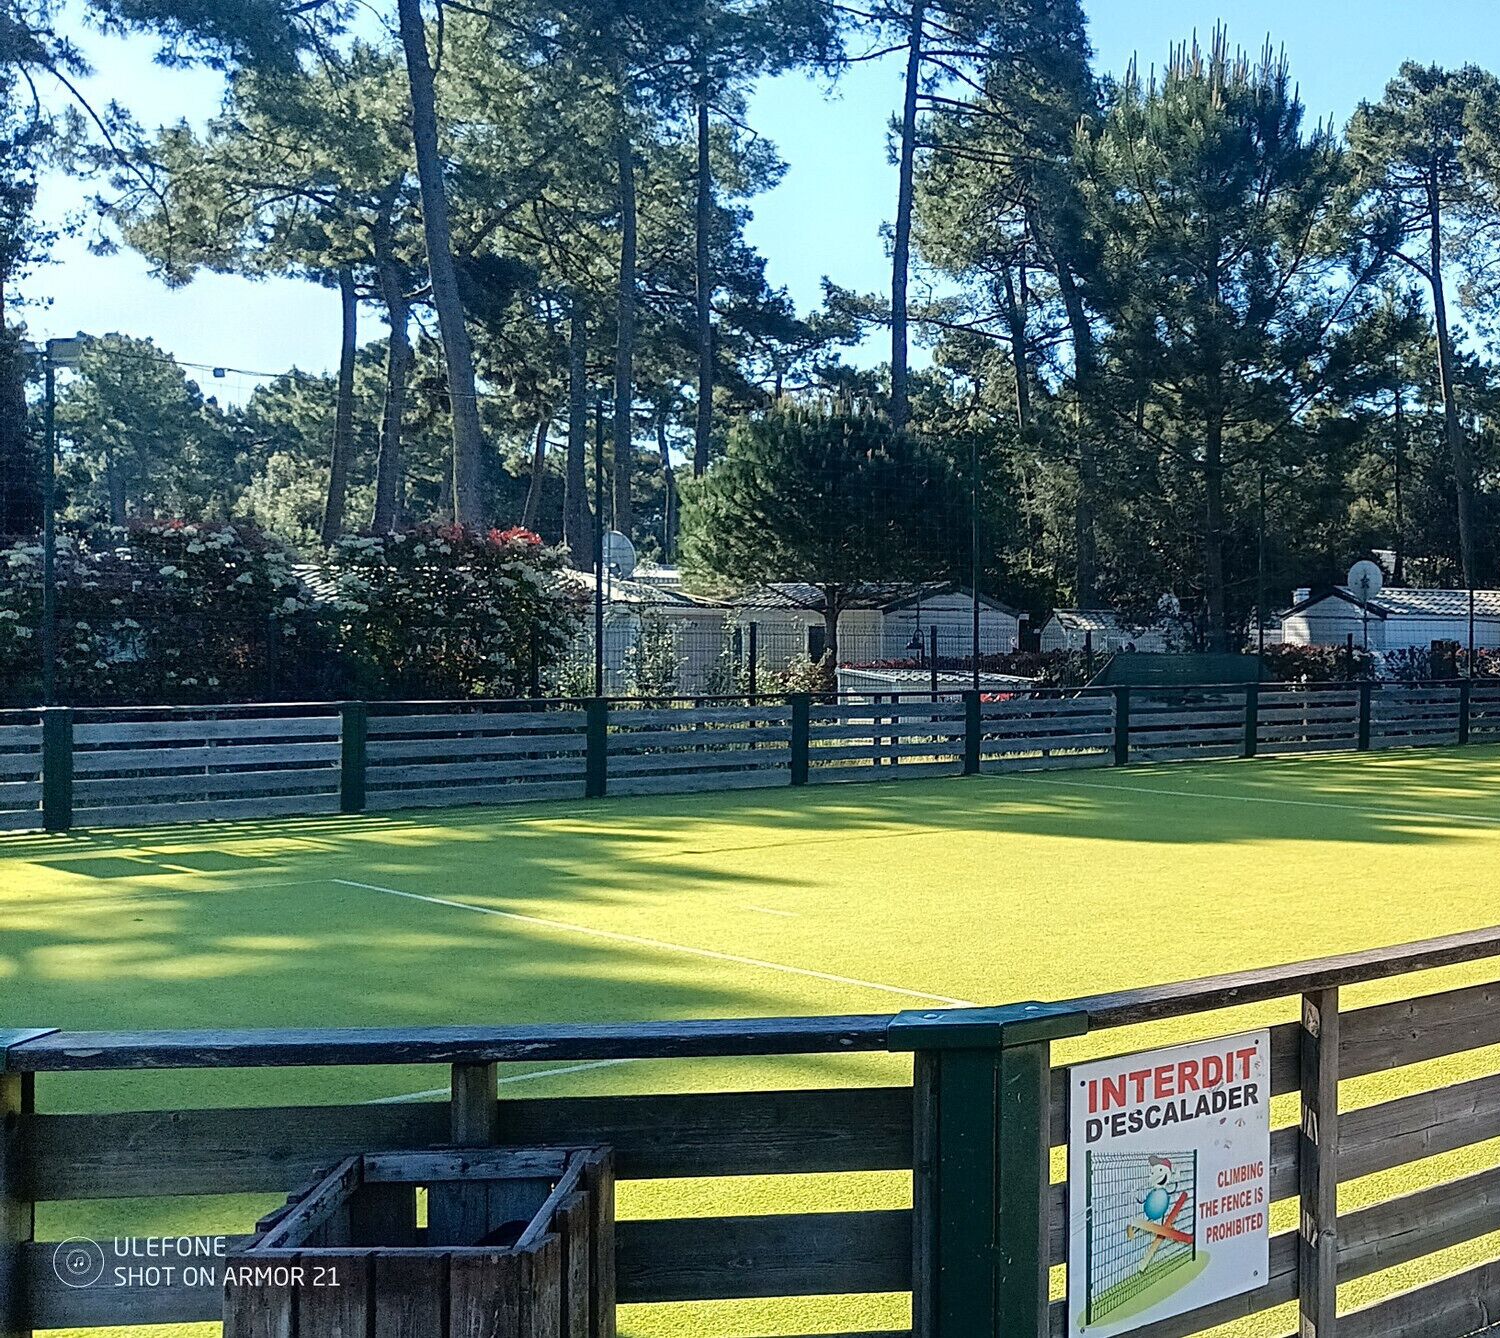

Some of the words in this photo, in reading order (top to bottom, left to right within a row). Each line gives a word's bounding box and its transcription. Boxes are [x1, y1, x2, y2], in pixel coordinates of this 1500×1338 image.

[1088, 1047, 1257, 1113] INTERDIT
[1085, 1083, 1258, 1143] D'ESCALADER
[1217, 1161, 1264, 1188] CLIMBING
[1199, 1199, 1218, 1219] THE
[1221, 1190, 1252, 1213] FENCE
[1254, 1187, 1264, 1204] IS
[1206, 1212, 1263, 1244] PROHIBITED
